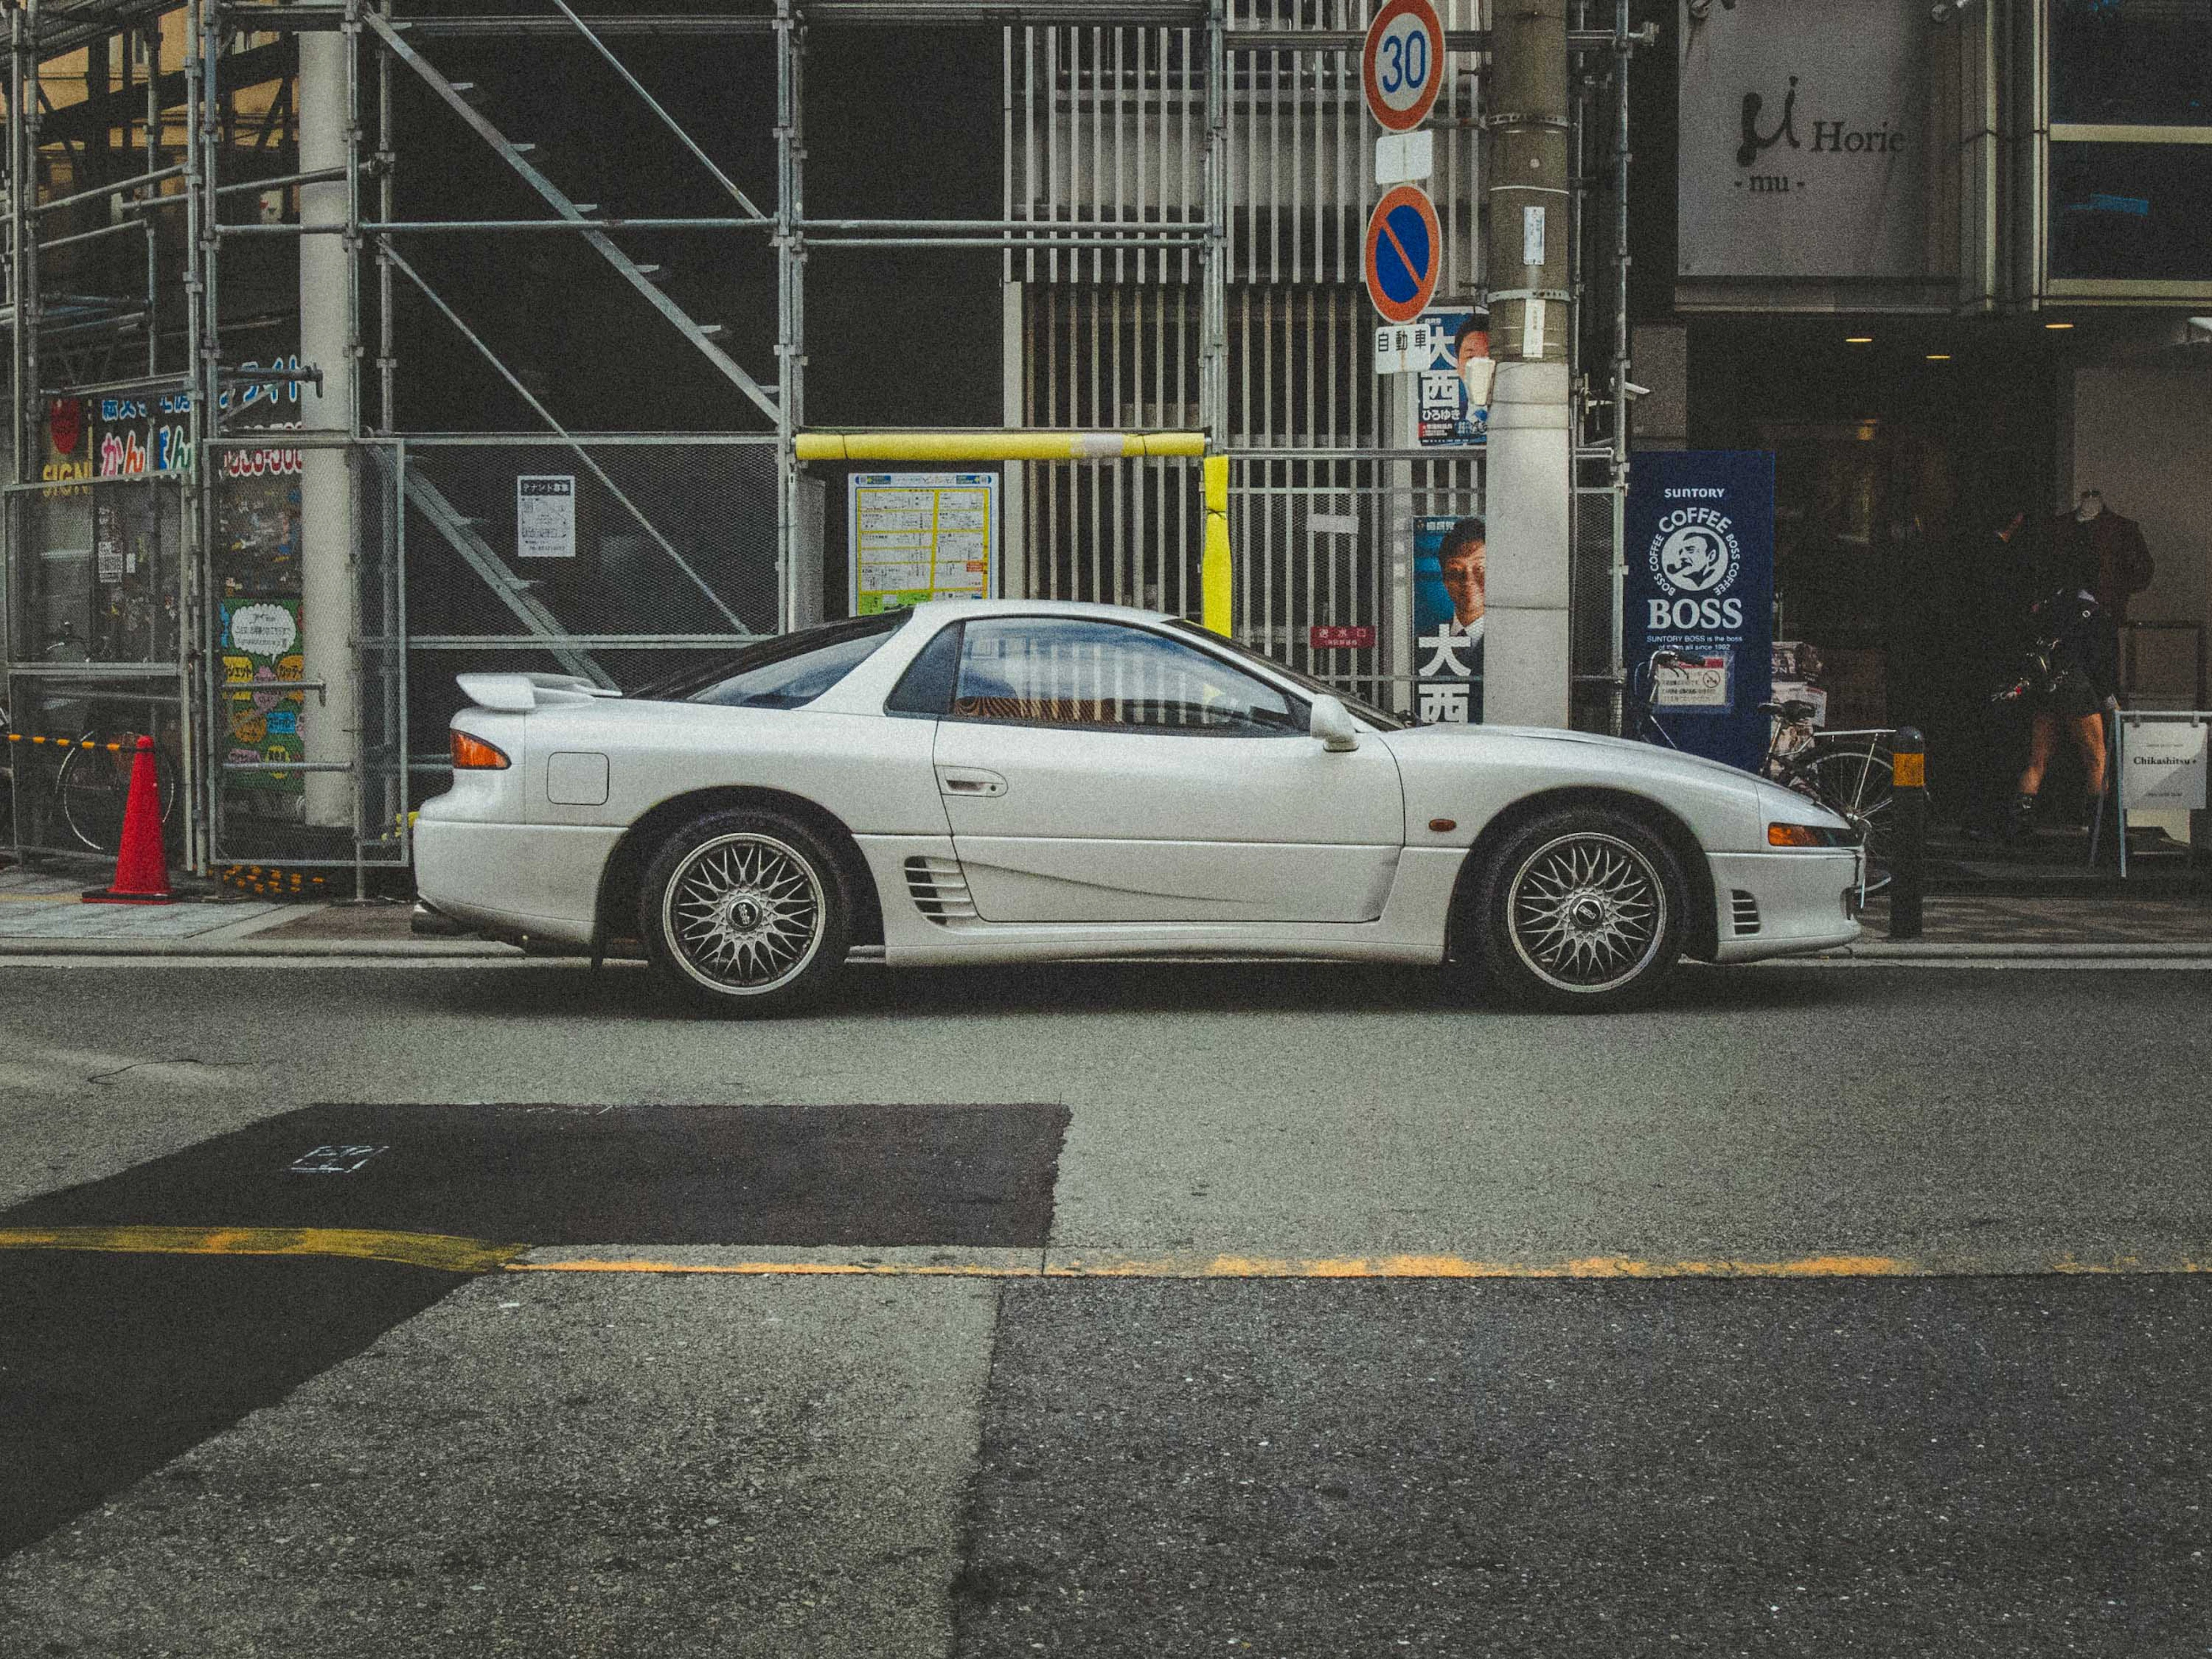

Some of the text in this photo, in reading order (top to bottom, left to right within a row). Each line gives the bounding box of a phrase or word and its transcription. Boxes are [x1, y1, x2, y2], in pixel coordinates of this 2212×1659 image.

[1382, 30, 1426, 93] 30
[1810, 121, 1905, 153] Horie
[1378, 329, 1427, 353] 自動車
[1422, 409, 1461, 421] ひろゆき
[1664, 488, 1725, 498] SUNTORY
[1658, 506, 1732, 534] COFFEE
[1649, 535, 1676, 596] BOSS COFFEE
[1713, 533, 1741, 596] BOSS COFFEE
[1647, 599, 1743, 629] BOSS
[1418, 624, 1471, 724] 大西
[2134, 756, 2190, 764] Chikashitsu
